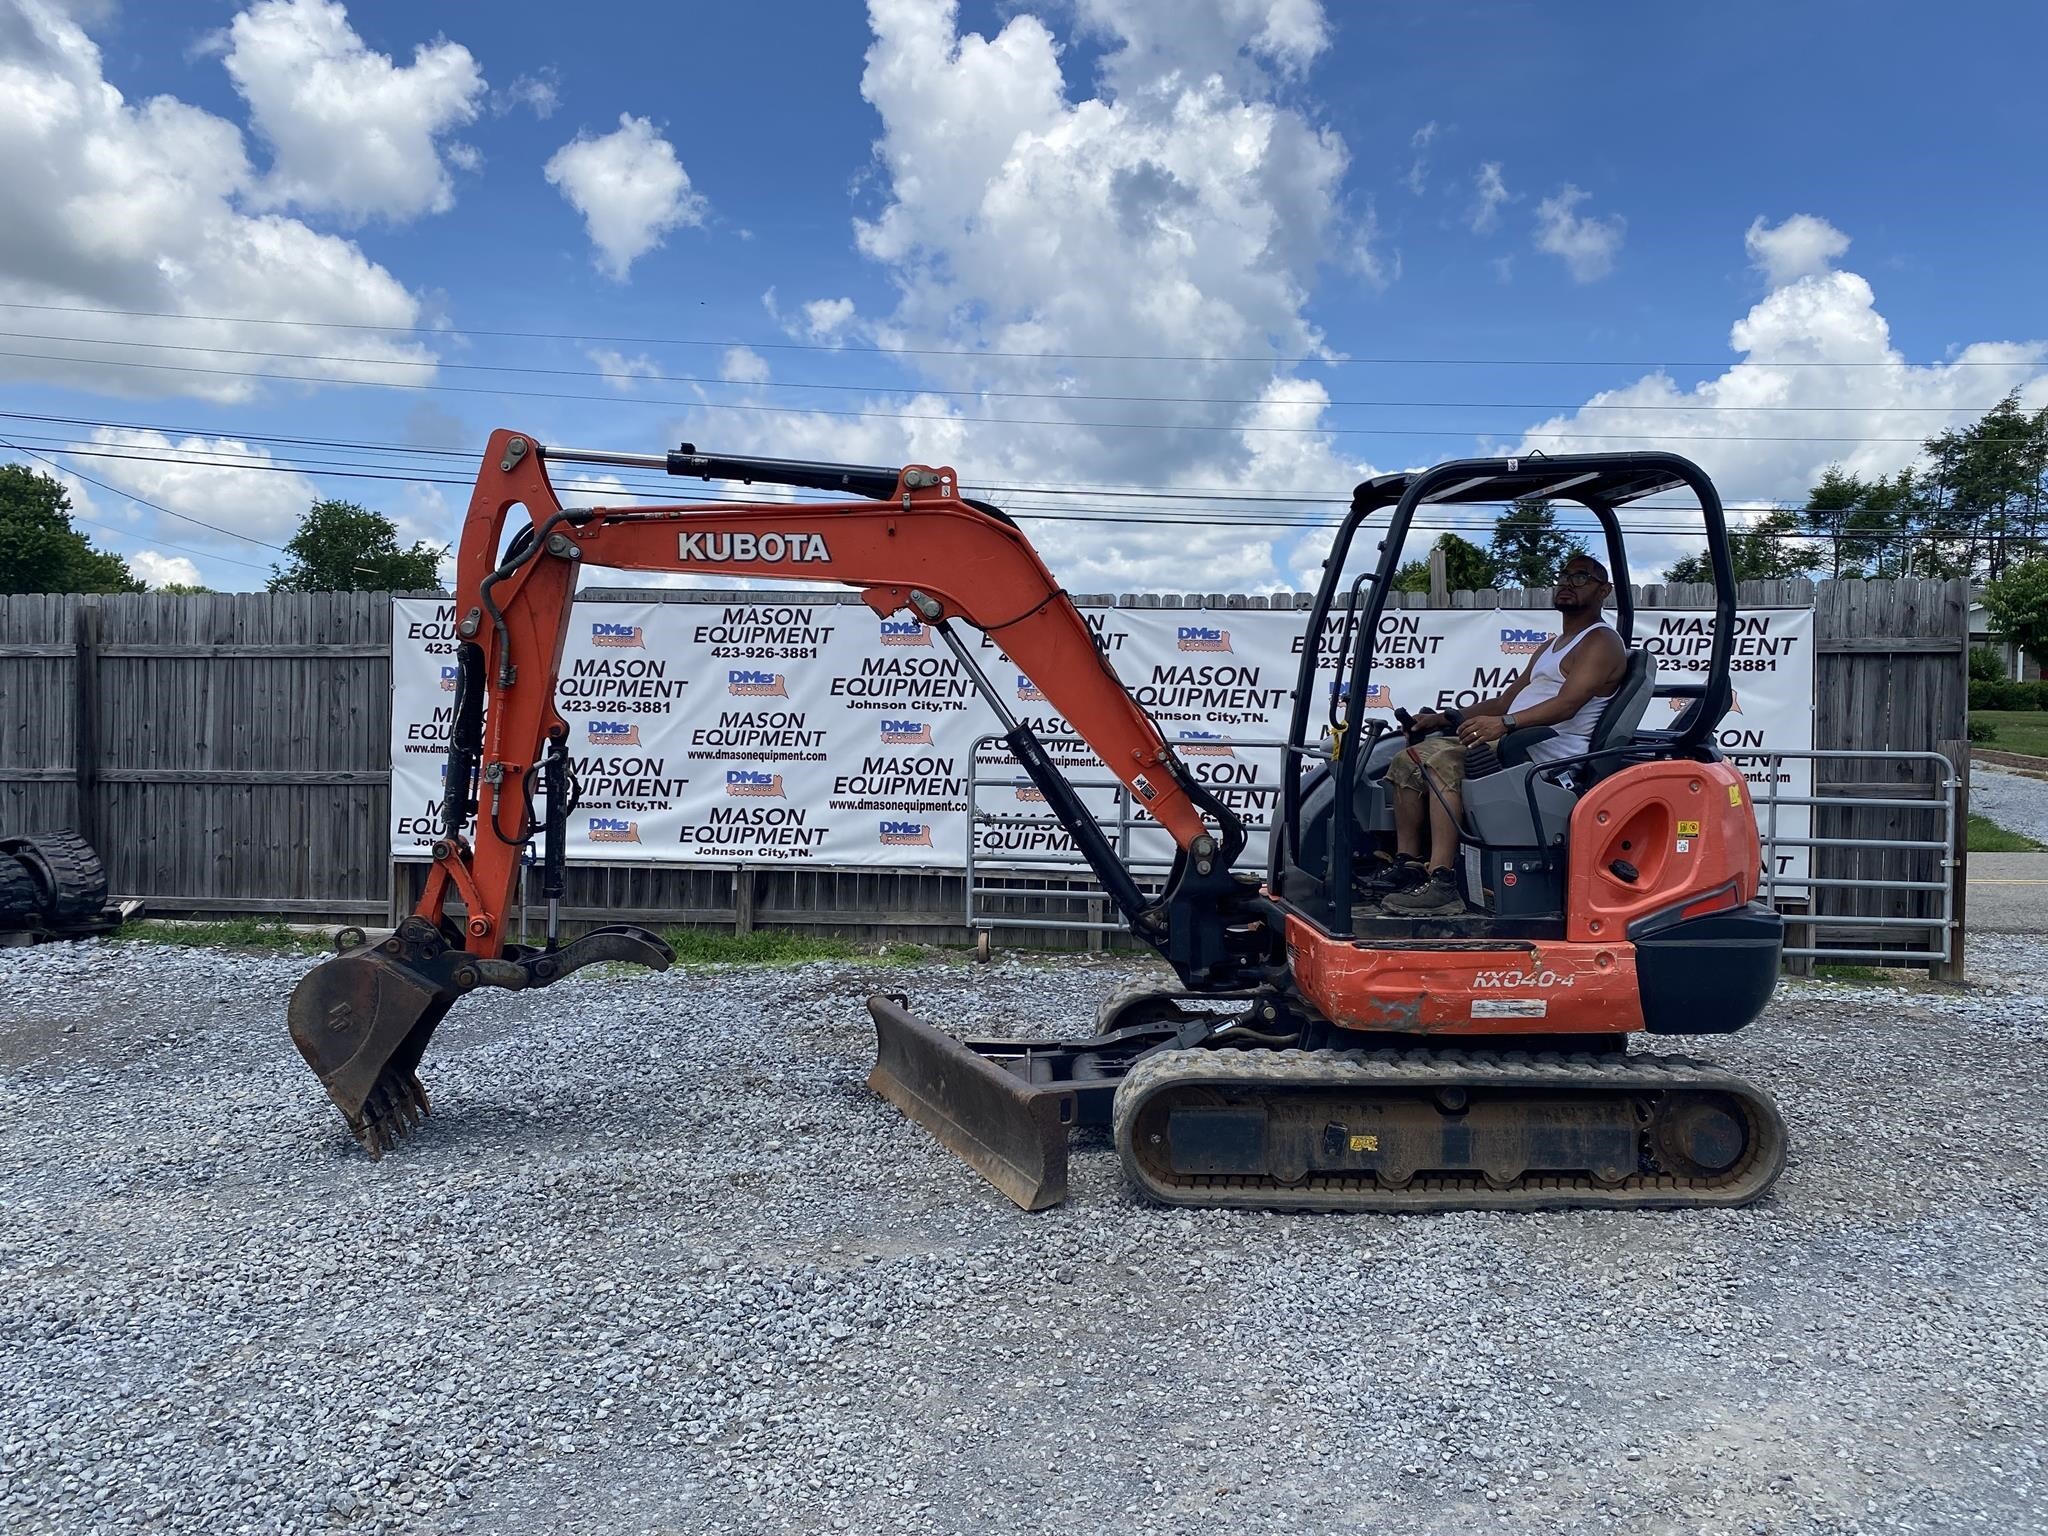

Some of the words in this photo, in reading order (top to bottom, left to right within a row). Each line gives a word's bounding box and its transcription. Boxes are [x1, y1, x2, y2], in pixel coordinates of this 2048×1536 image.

[677, 532, 831, 562] KUBOTA
[722, 608, 813, 625] MASON
[1322, 616, 1420, 634] MAON
[694, 627, 834, 644] EQUIPMENT
[711, 647, 817, 659] 423-926-3881
[1630, 637, 1797, 656] EQUIPENT
[573, 660, 666, 678] MASON
[861, 658, 960, 677] MASON
[1316, 657, 1425, 669] 2396-3881
[1657, 659, 1777, 671] 23-923881
[1151, 665, 1260, 687] MASON
[556, 678, 688, 698] QUIPMENT
[830, 678, 978, 698] EQUIPMENT
[561, 701, 672, 713] 423-926-3881
[846, 700, 907, 710] Johnson
[911, 701, 967, 712] City,TN.
[719, 712, 805, 728] MASON
[1147, 710, 1201, 721] ohnson
[1206, 712, 1269, 724] City,TN.
[692, 730, 826, 747] EQUIPMENT
[688, 750, 827, 762] www.dmasonequipment.com
[568, 757, 664, 776] MASON
[862, 757, 954, 776] MASON
[1184, 763, 1258, 784] SON
[534, 777, 689, 797] EIPMENT
[616, 801, 672, 812] City,TN.
[829, 799, 967, 813] www.dmasonequipment.co
[709, 808, 806, 826] MASON
[679, 826, 829, 845] EQUIPMENT
[974, 832, 1120, 851] EQUIPMT
[694, 847, 753, 857] Johnson
[757, 848, 813, 858] City,TN.
[1473, 970, 1576, 988] KX040-4
